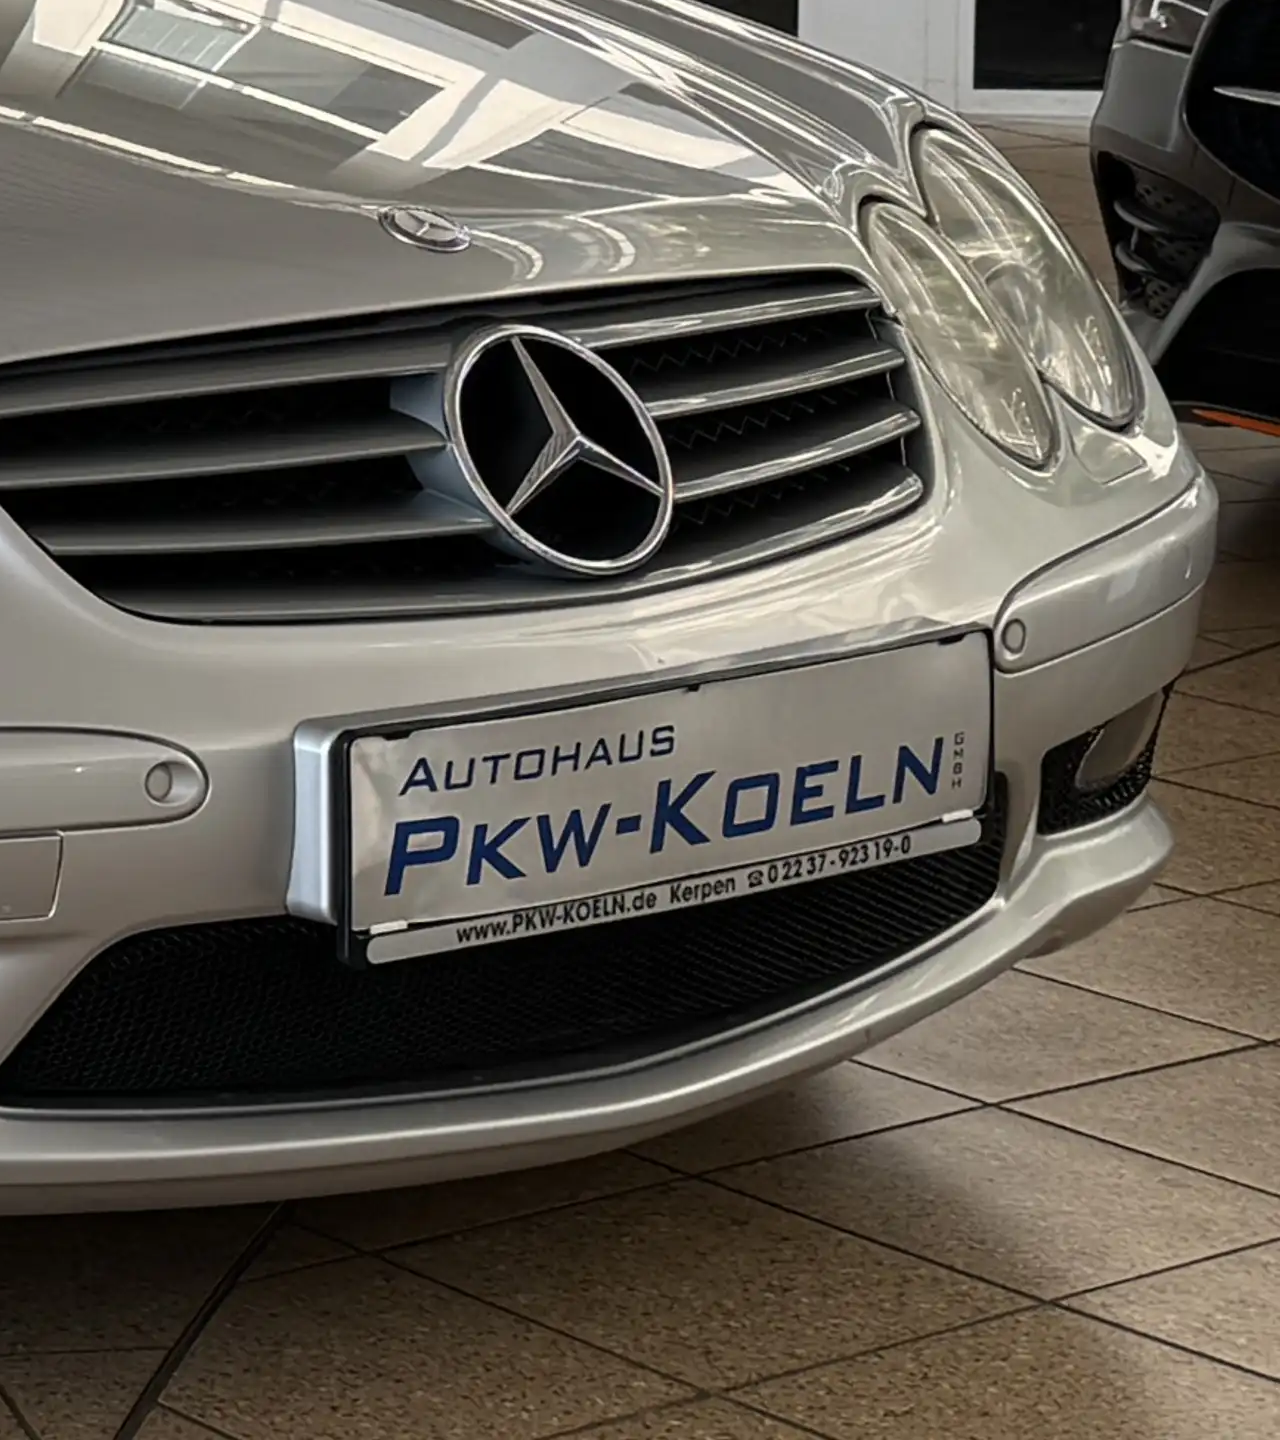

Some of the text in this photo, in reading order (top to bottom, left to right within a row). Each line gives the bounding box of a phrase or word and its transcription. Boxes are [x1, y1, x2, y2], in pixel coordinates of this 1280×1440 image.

[397, 725, 675, 796] AUTOHAUS
[384, 736, 944, 896] PKW-KOELN
[456, 890, 657, 943] www.PKW-KOELN.de
[669, 875, 737, 904] Kerpen
